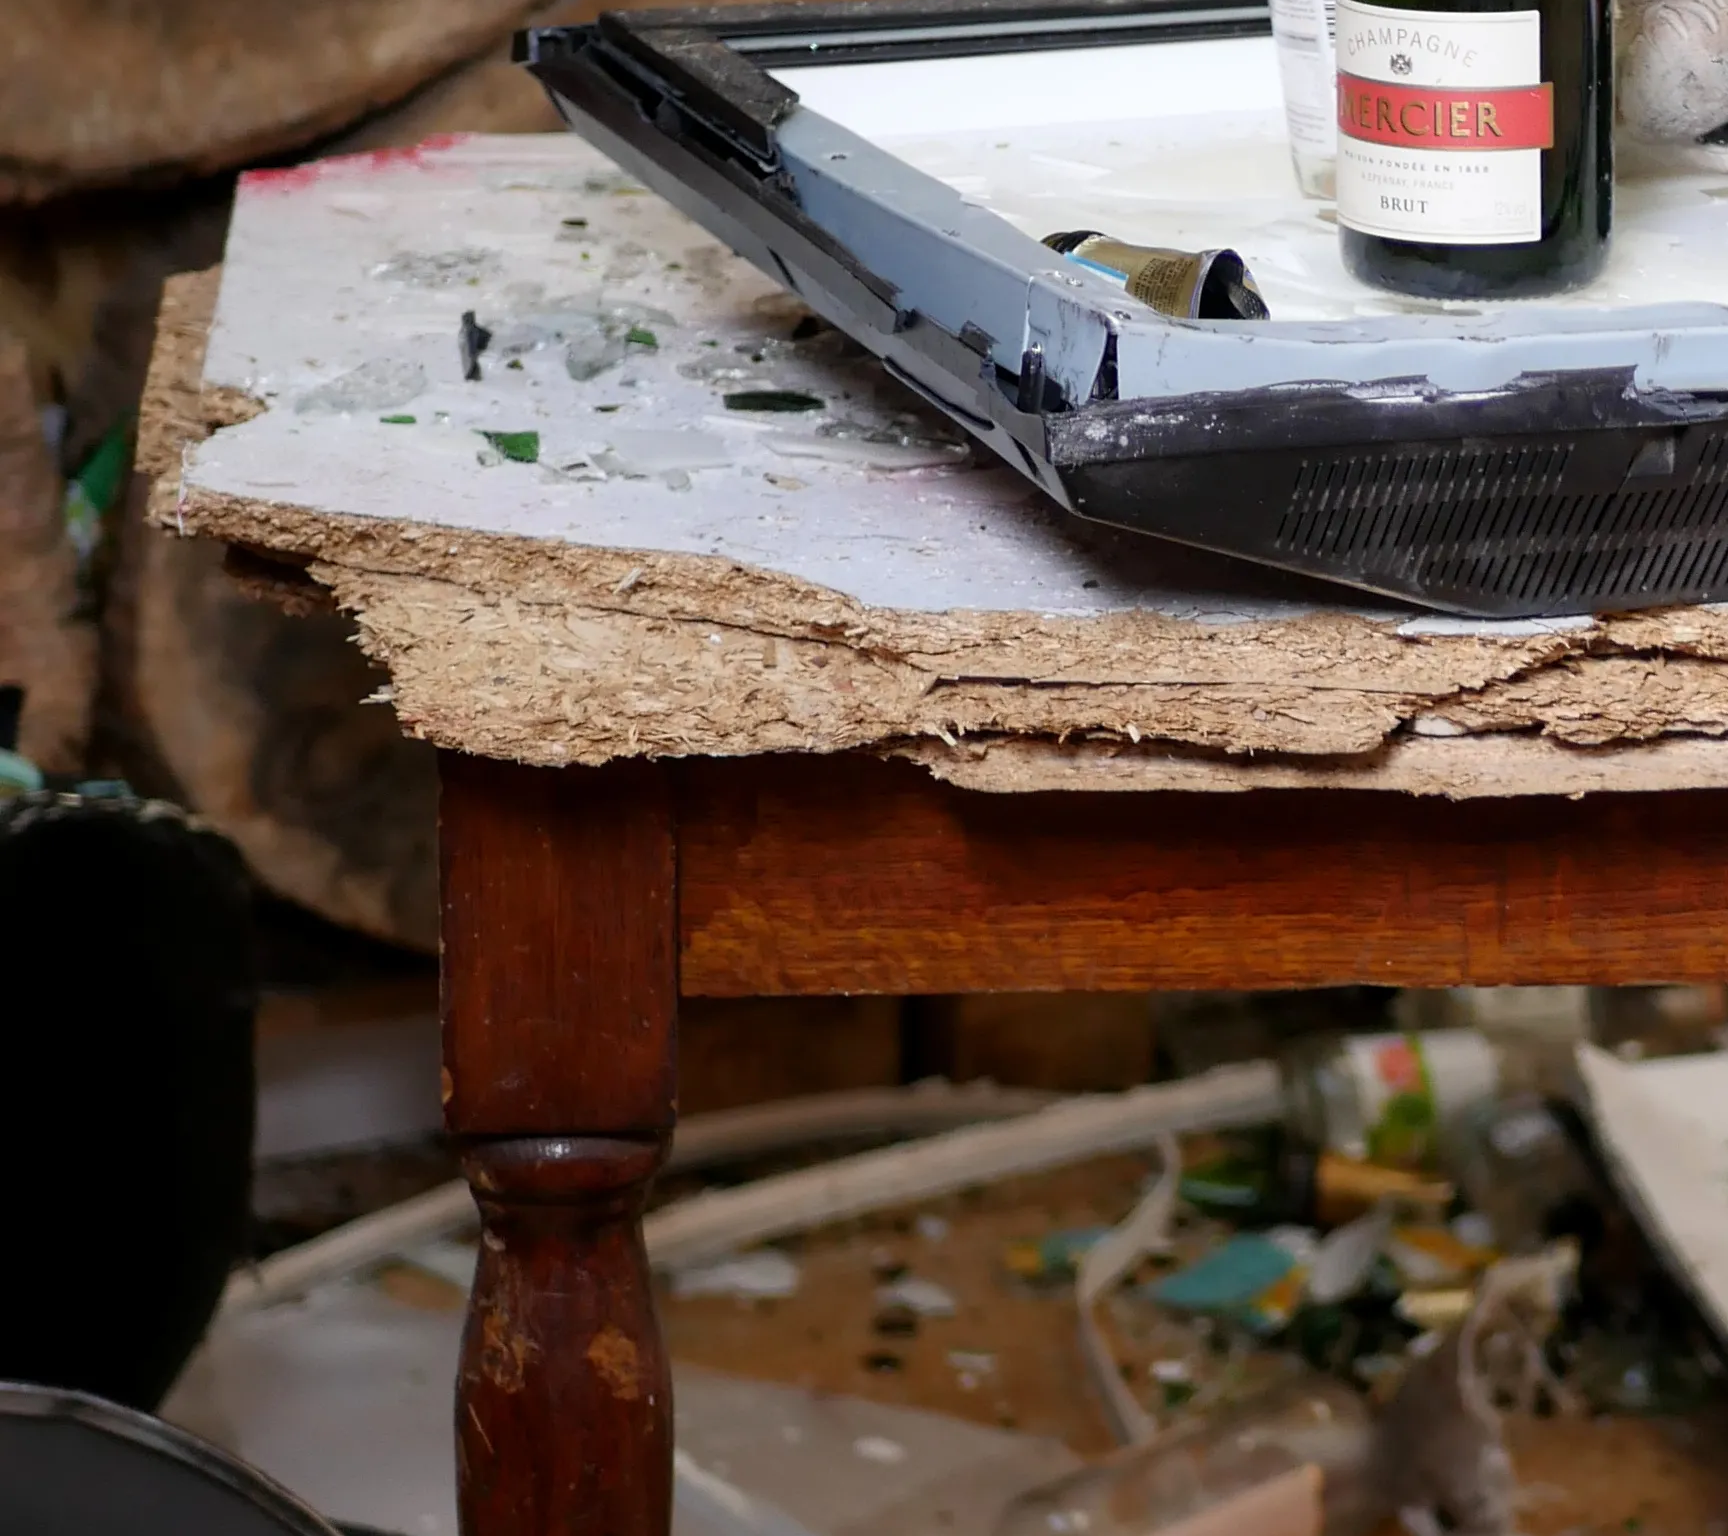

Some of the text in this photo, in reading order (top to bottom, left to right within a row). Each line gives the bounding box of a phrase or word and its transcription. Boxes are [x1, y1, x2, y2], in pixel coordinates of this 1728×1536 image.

[1348, 27, 1478, 68] CHAMPAGNE
[1341, 88, 1503, 138] MERCIER
[1380, 195, 1429, 215] BRUT
